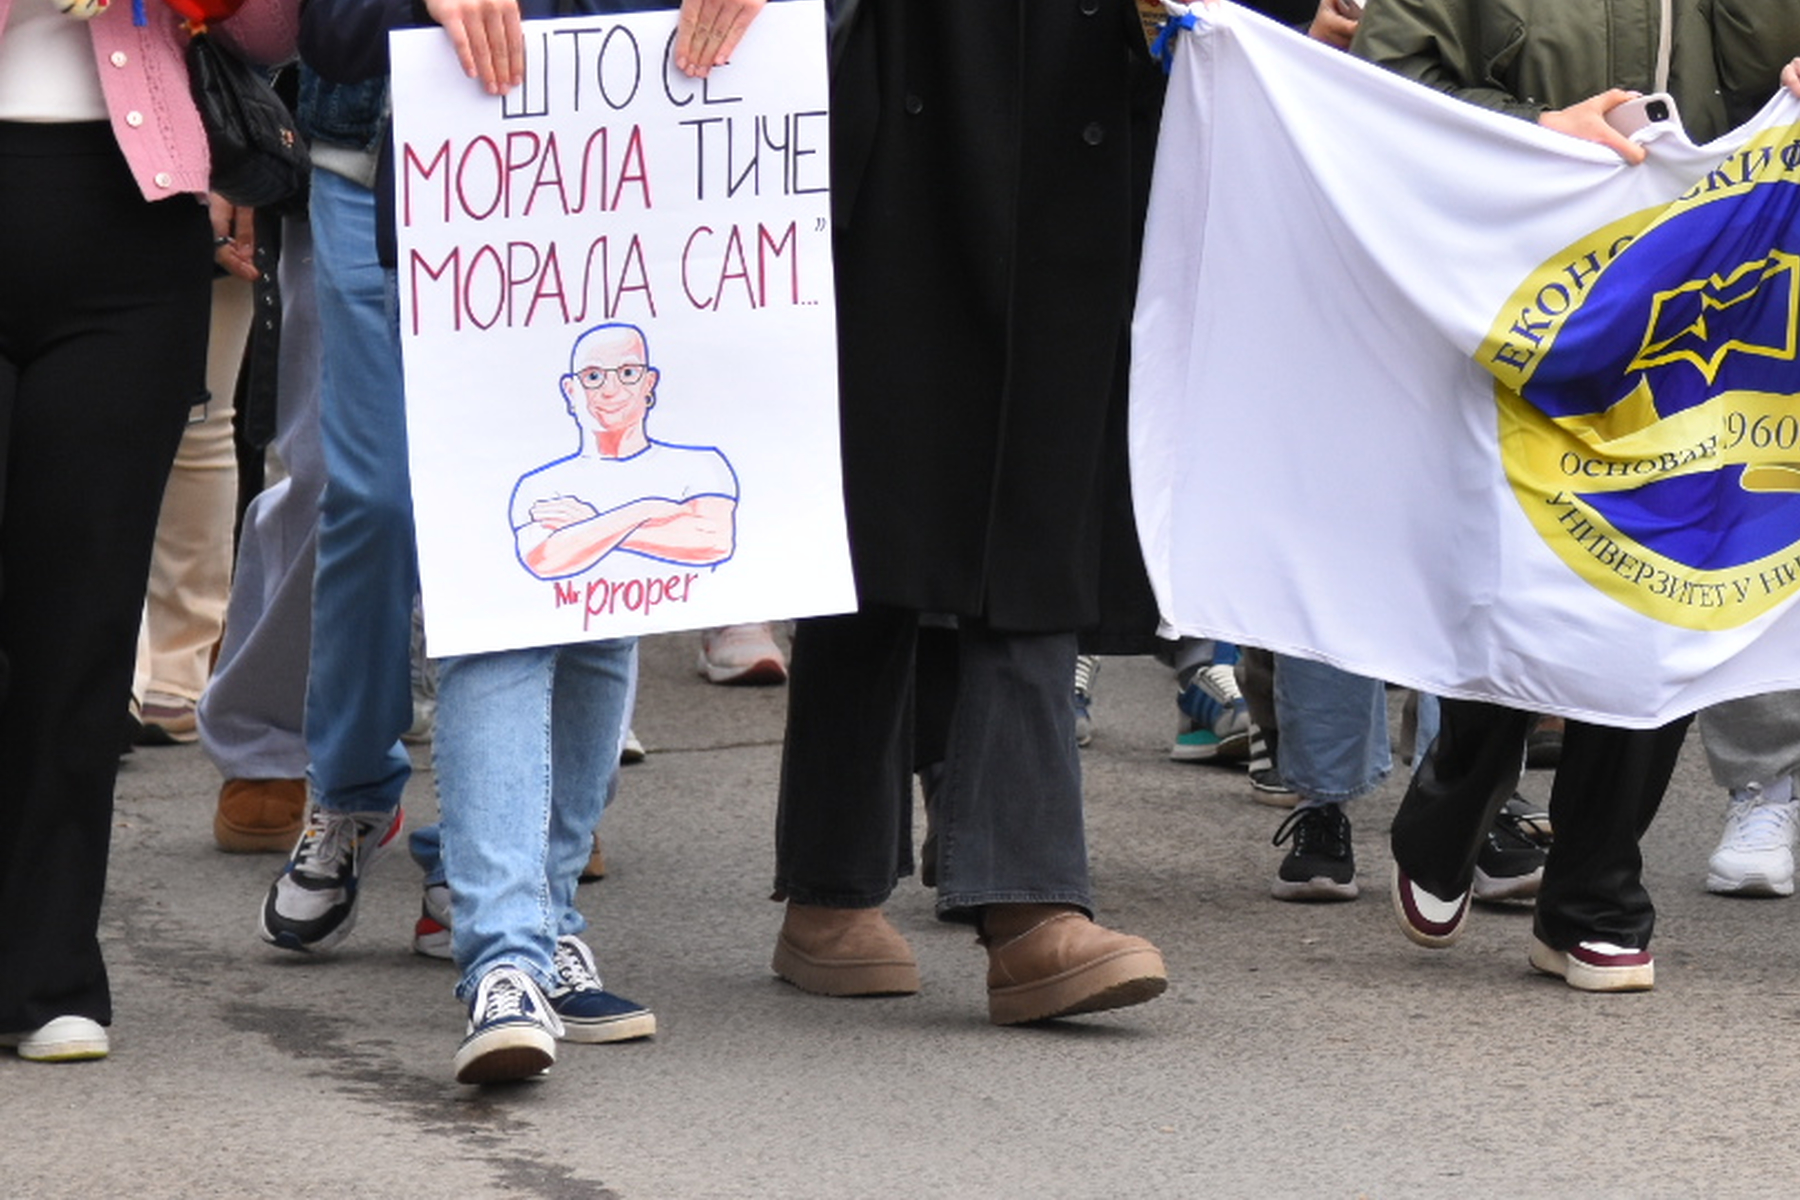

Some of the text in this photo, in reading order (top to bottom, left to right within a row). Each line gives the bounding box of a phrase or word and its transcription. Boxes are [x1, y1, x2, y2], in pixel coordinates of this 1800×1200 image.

[501, 23, 641, 119] ШТО
[403, 111, 830, 227] МОРАЛА ТИЧЕ
[410, 234, 657, 336] МОРАЛА
[1545, 491, 1728, 607] УНИВЕРЗИТЕТ
[1733, 577, 1751, 603] У
[583, 573, 699, 631] proper
